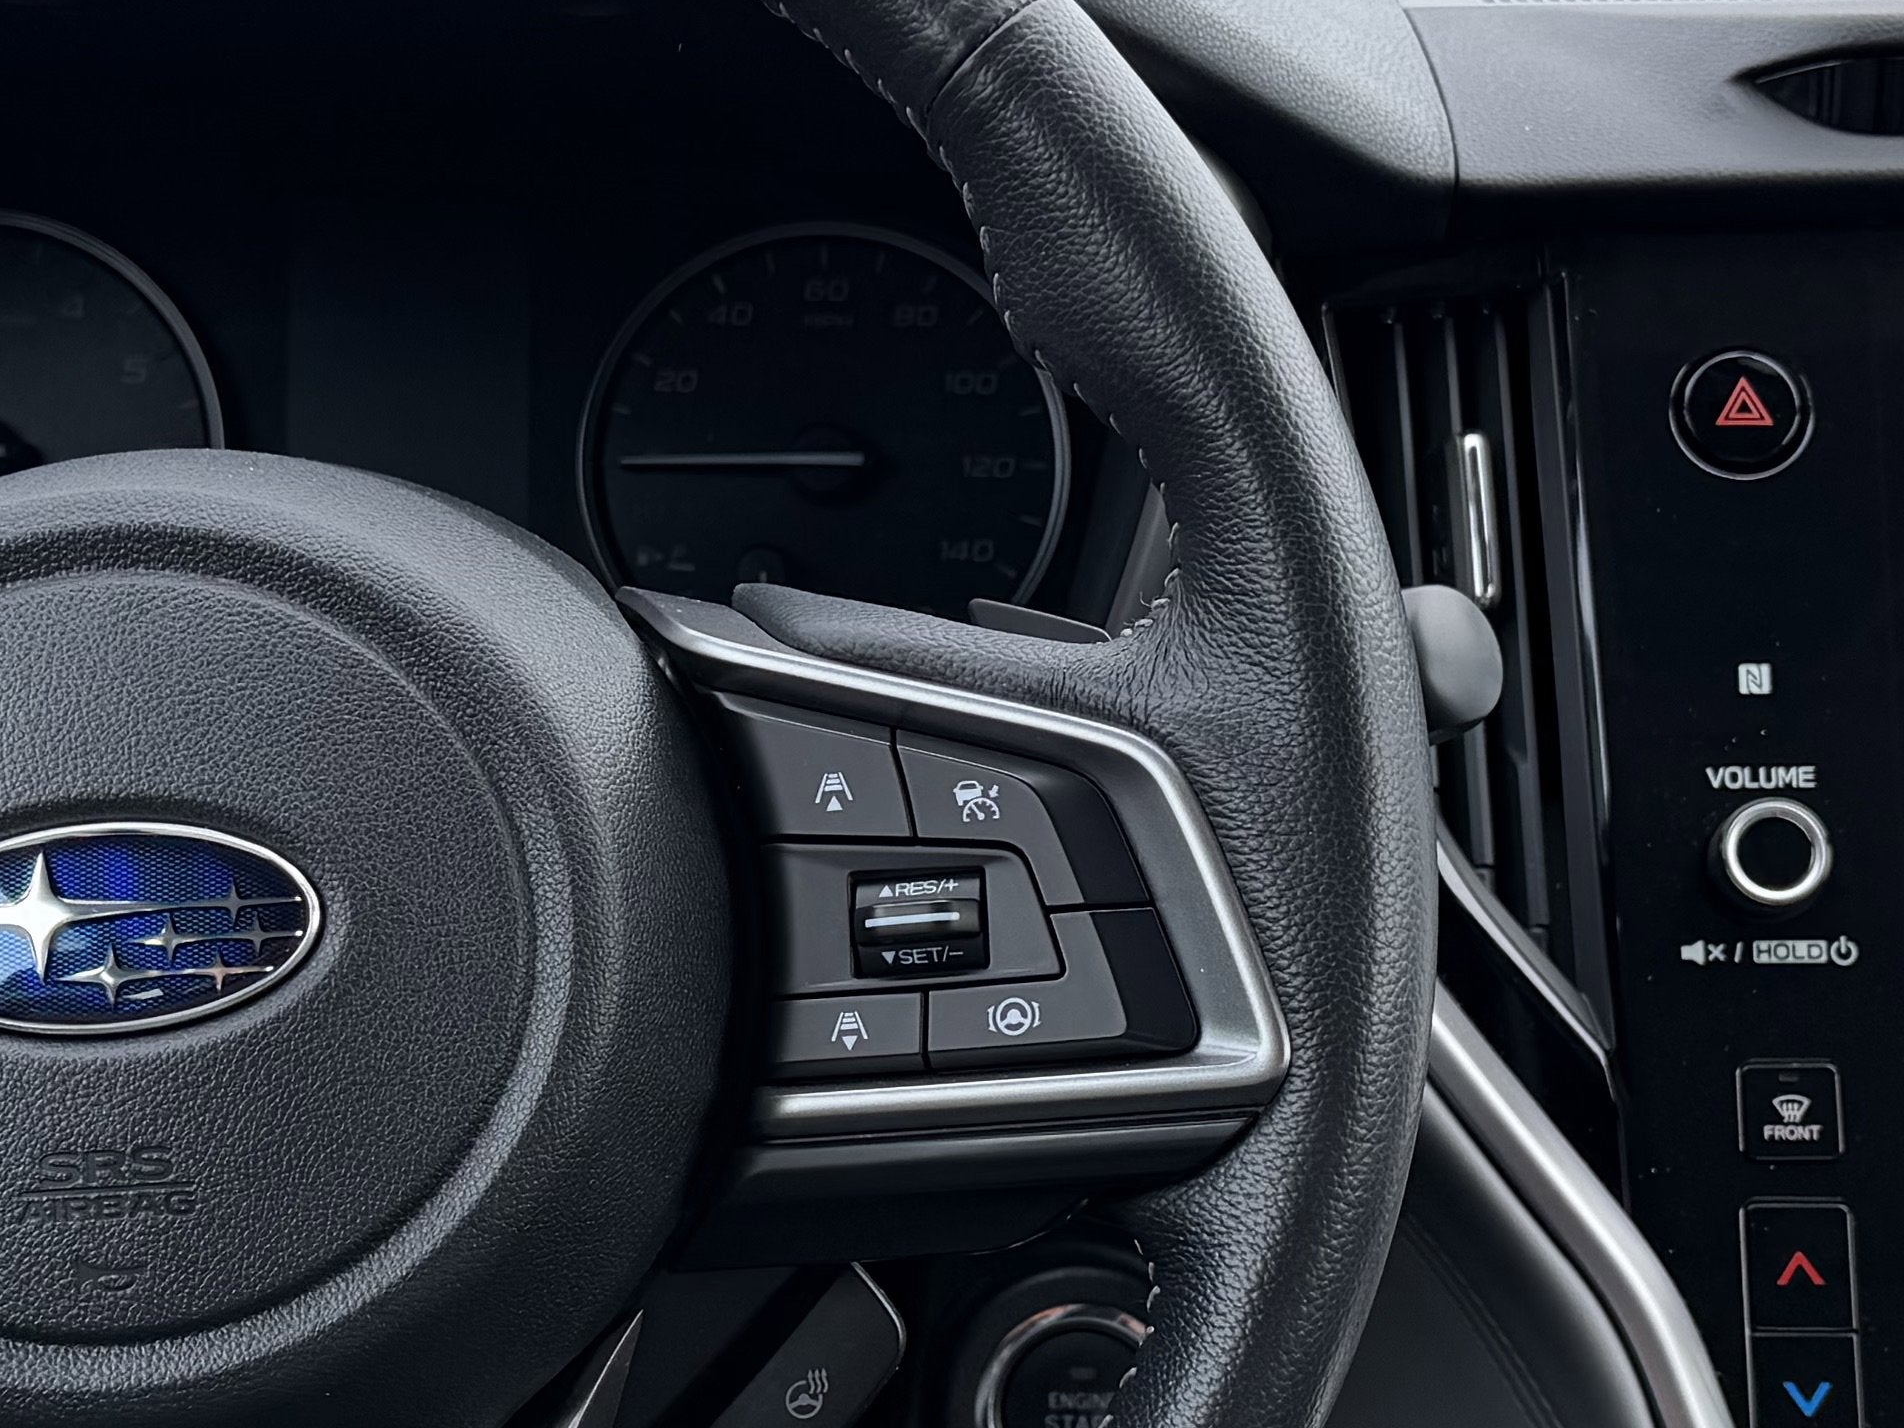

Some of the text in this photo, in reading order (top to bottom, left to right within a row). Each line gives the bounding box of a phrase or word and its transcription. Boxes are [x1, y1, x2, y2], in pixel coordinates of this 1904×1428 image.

[1705, 765, 1817, 790] VOLUME
[1754, 941, 1825, 963] HOLD
[1763, 1124, 1824, 1142] FRONT
[37, 1148, 178, 1186] SRS
[14, 1189, 201, 1222] AIRBAG
[1047, 1391, 1116, 1409] ENGIN
